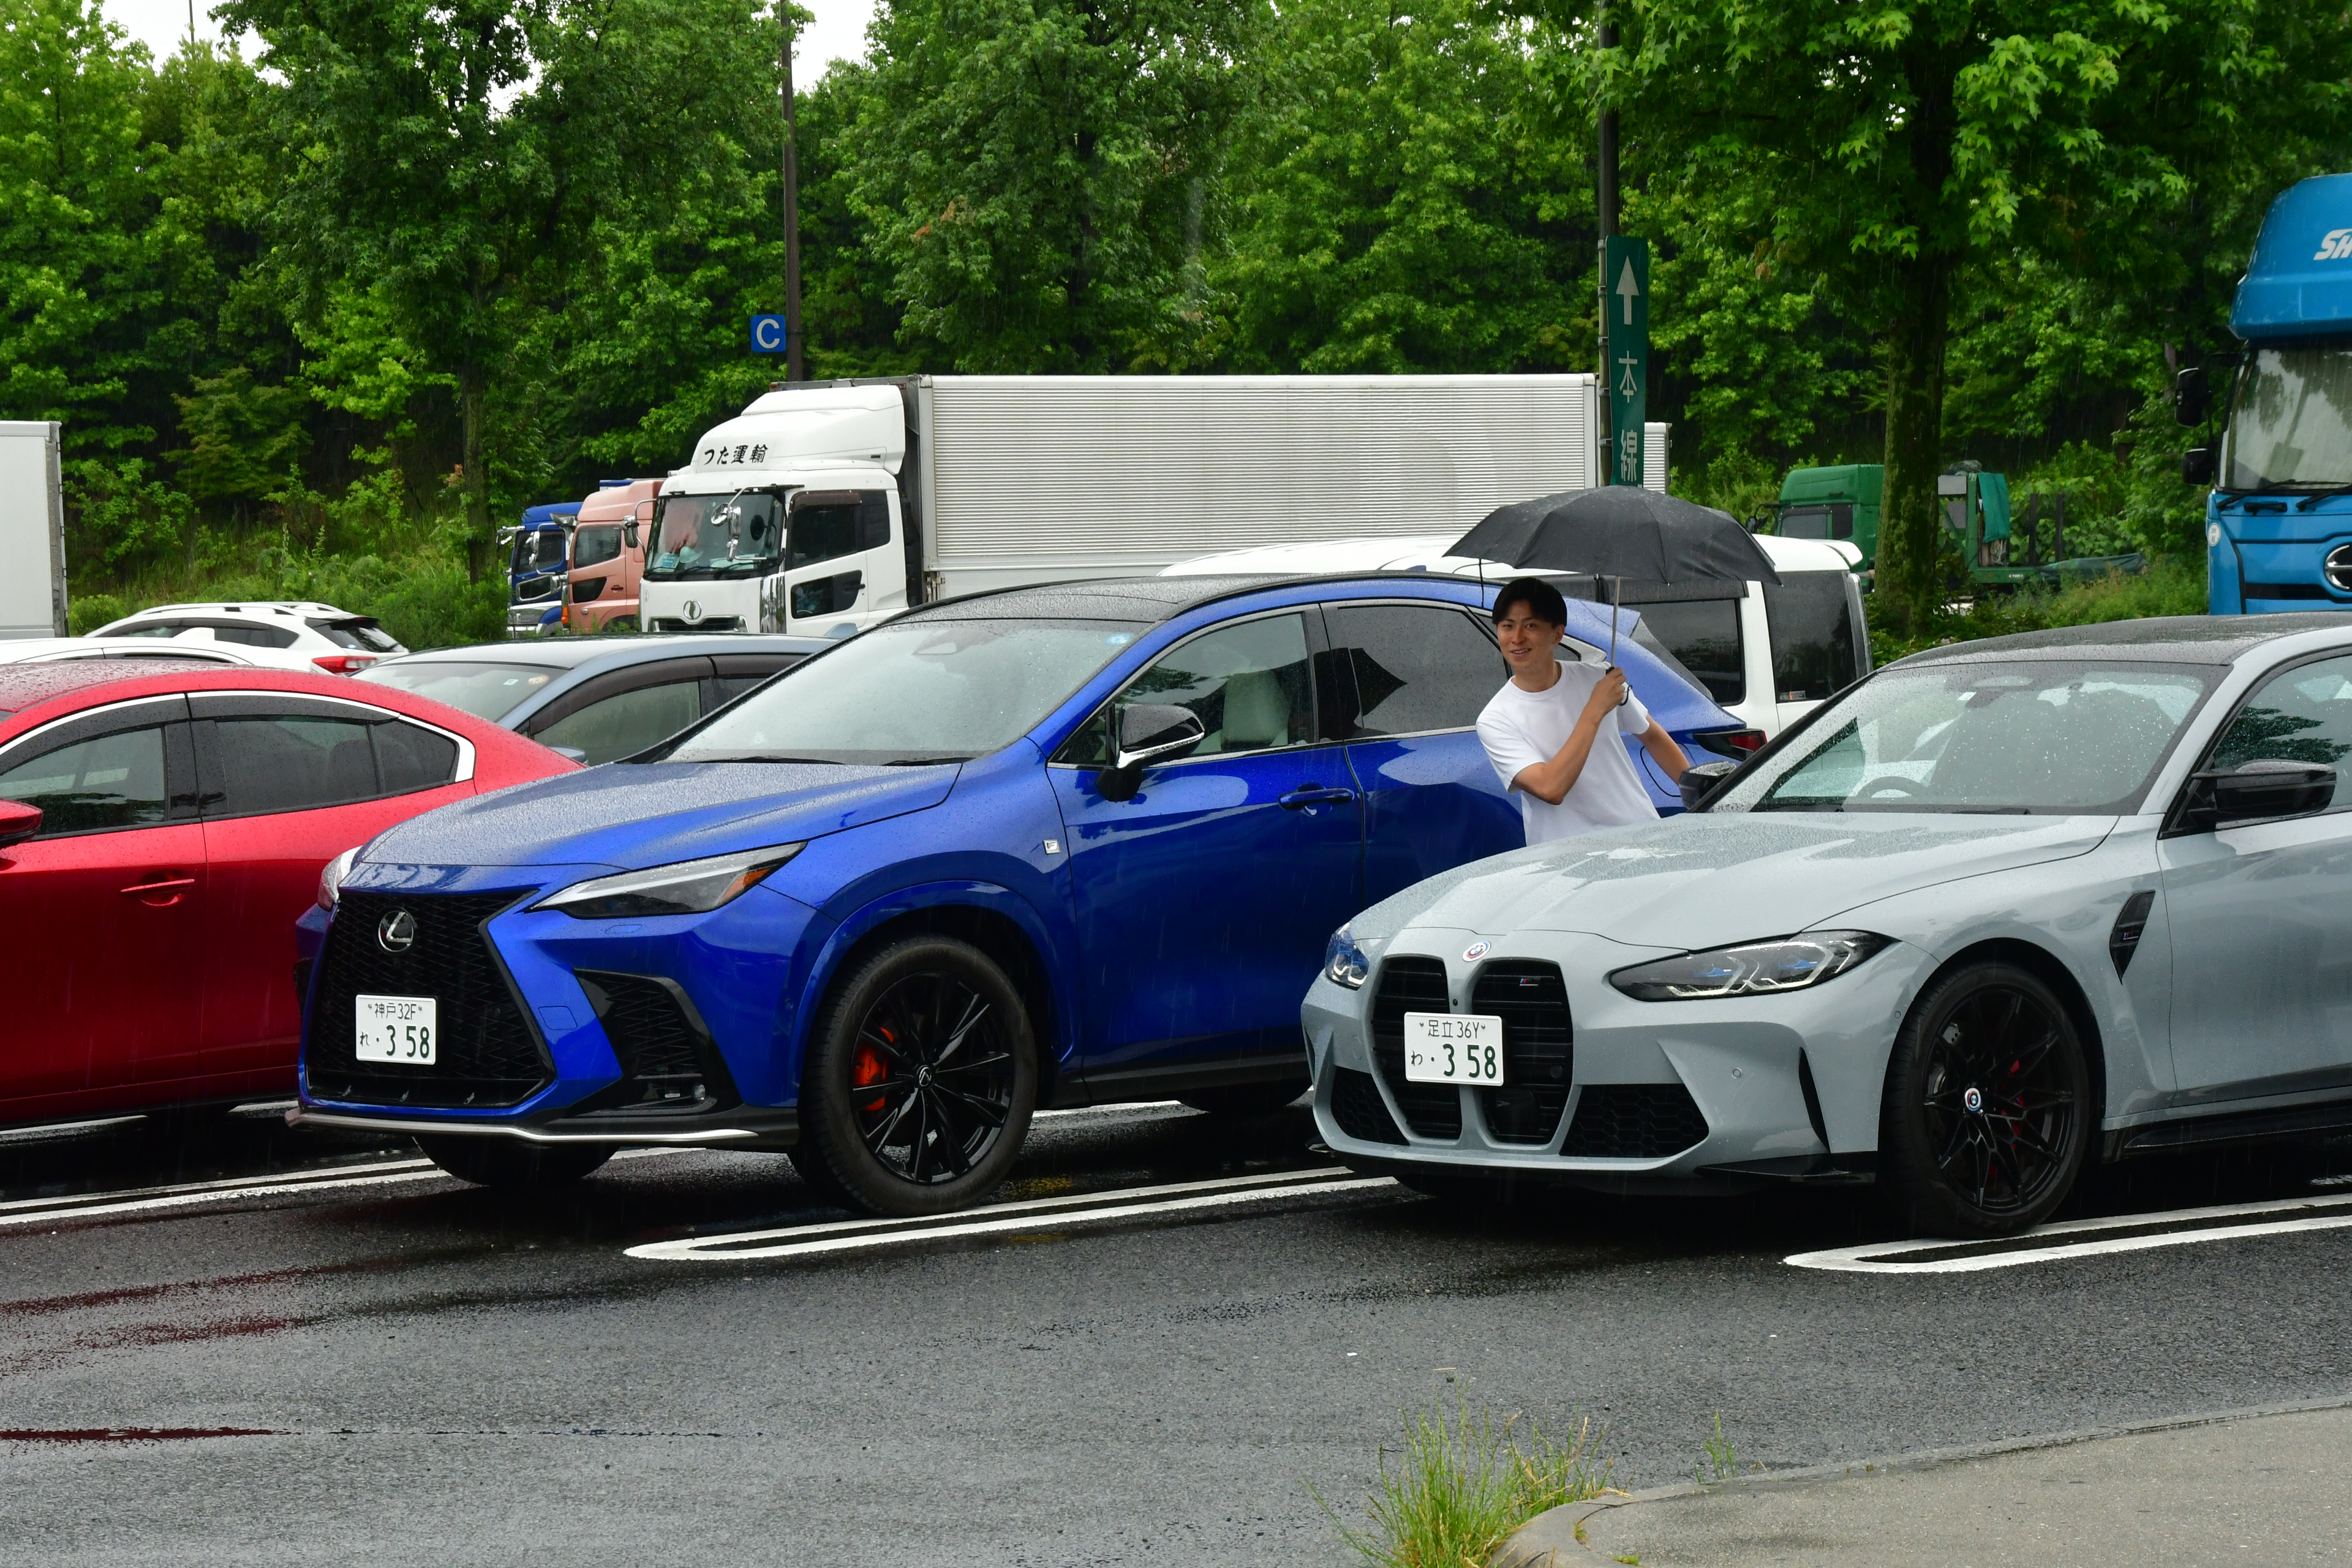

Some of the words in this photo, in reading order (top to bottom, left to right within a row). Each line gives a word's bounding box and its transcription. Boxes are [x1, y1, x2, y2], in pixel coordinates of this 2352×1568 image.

[2313, 228, 2352, 261] SH
[756, 318, 780, 349] C
[1618, 350, 1638, 482] 本線
[704, 443, 769, 465] つた運輸
